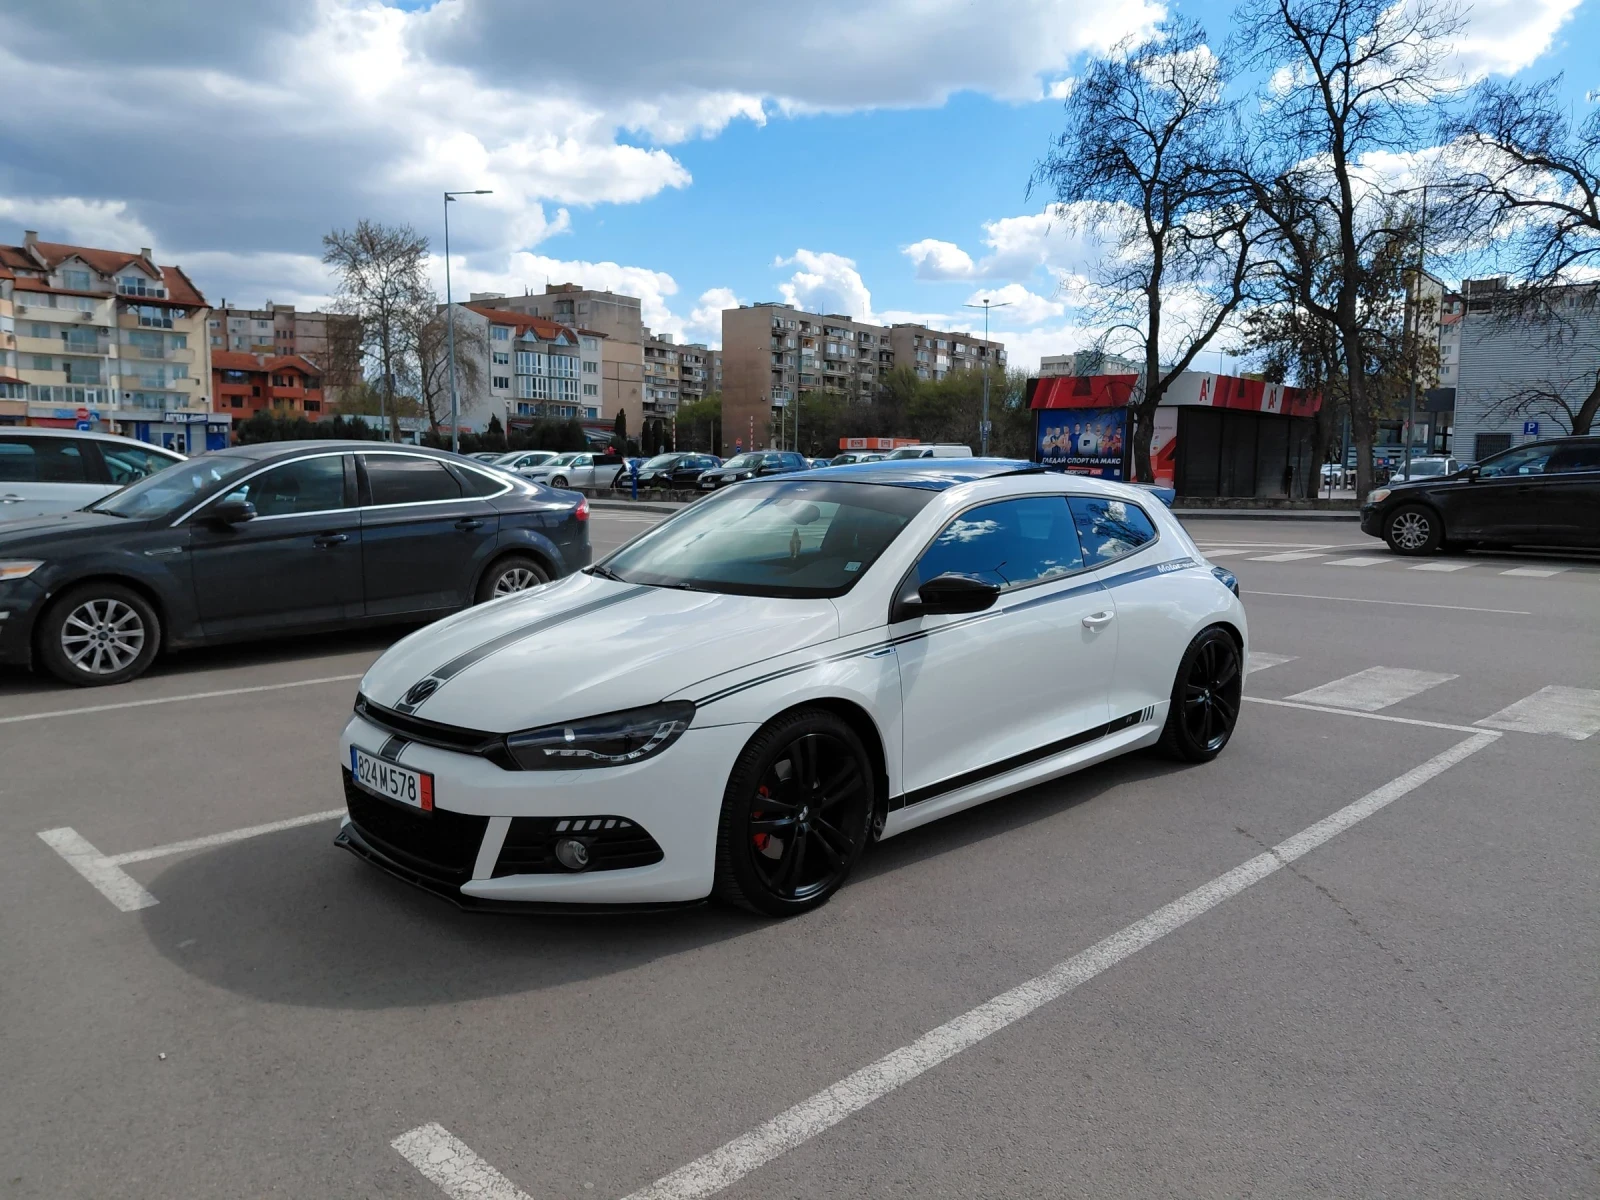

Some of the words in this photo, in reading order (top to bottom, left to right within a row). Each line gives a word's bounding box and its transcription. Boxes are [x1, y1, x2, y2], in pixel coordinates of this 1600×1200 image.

[1199, 377, 1210, 401] A1
[1268, 387, 1277, 409] A1
[1041, 456, 1066, 464] ГЛЕДАЙ
[1067, 457, 1089, 465] СПОРТ
